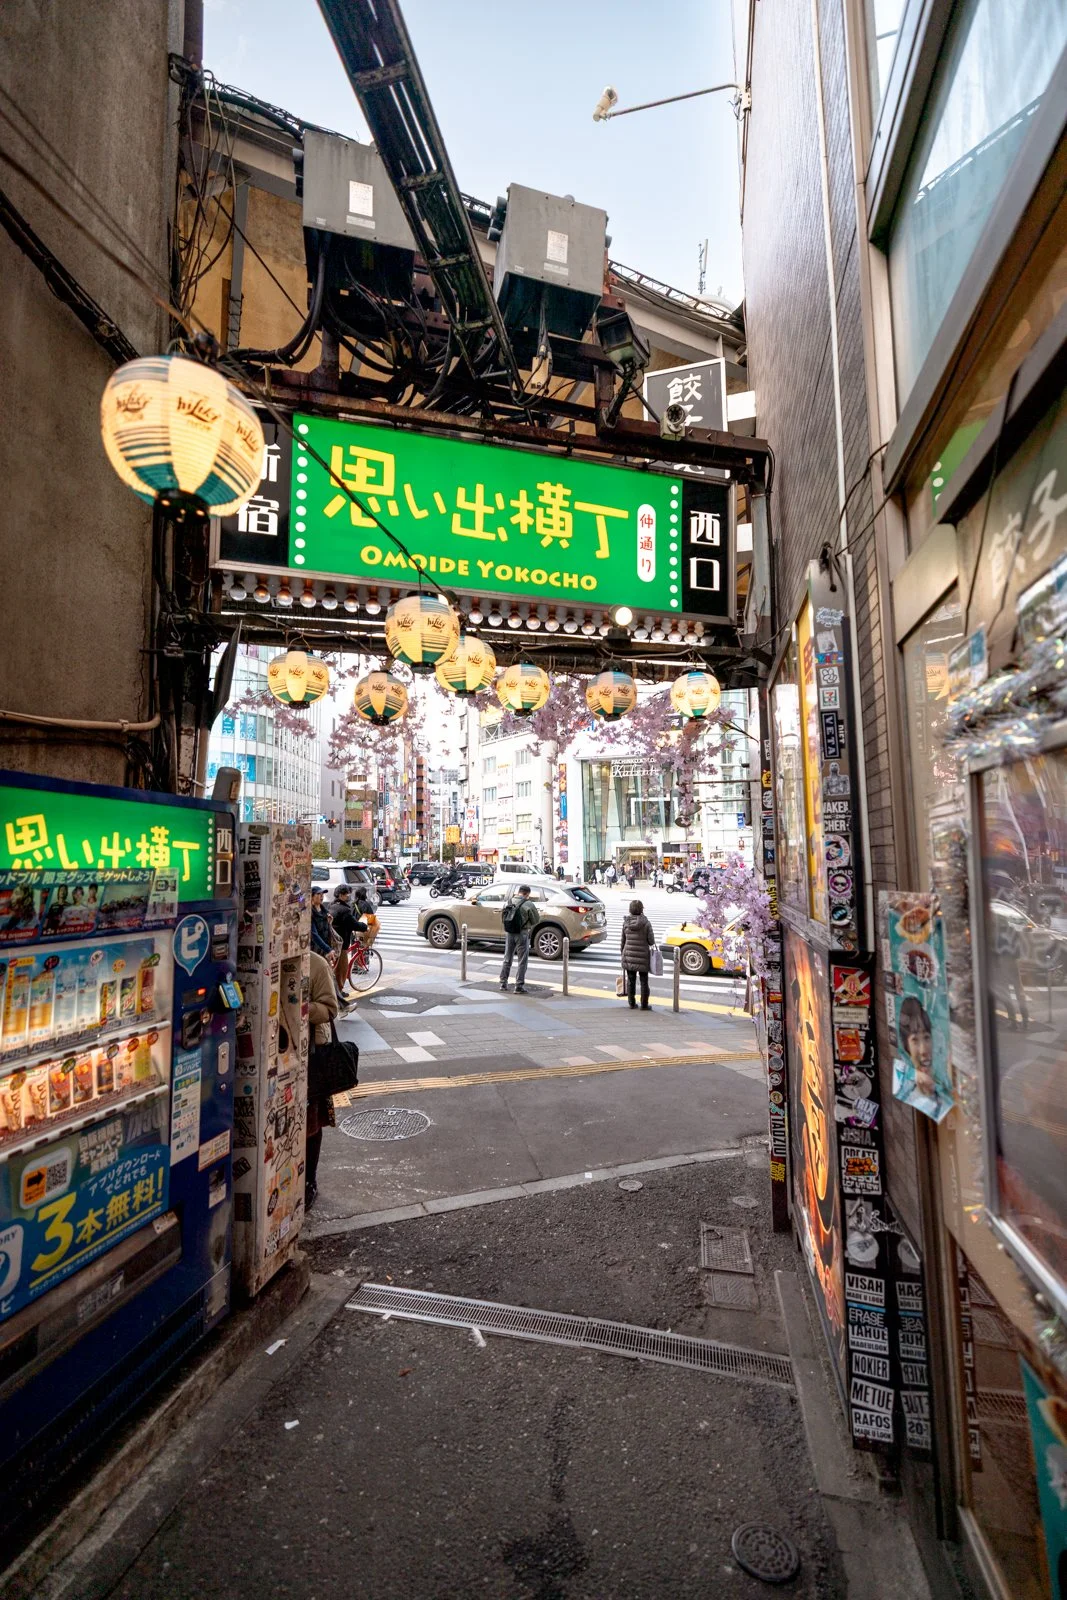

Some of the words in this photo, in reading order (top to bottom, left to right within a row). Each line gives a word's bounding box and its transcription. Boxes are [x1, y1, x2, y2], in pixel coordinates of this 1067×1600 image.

[323, 444, 629, 560] 思い出横丁
[639, 513, 653, 573] 仲通り
[689, 510, 720, 591] 西口
[360, 544, 469, 577] OMOIDE
[476, 559, 597, 592] YOKOCHO
[824, 715, 836, 756] VETA
[216, 828, 231, 885] 西口
[469, 876, 493, 885] S.RIDE
[181, 921, 205, 958] ピ
[846, 1291, 862, 1300] MADE
[869, 1296, 884, 1305] LOOK
[847, 1275, 883, 1293] VISAH
[849, 1308, 884, 1327] ERASE
[854, 1355, 888, 1378] NOKIER
[852, 1381, 893, 1410] METUE
[854, 1412, 890, 1429] RAFOS
